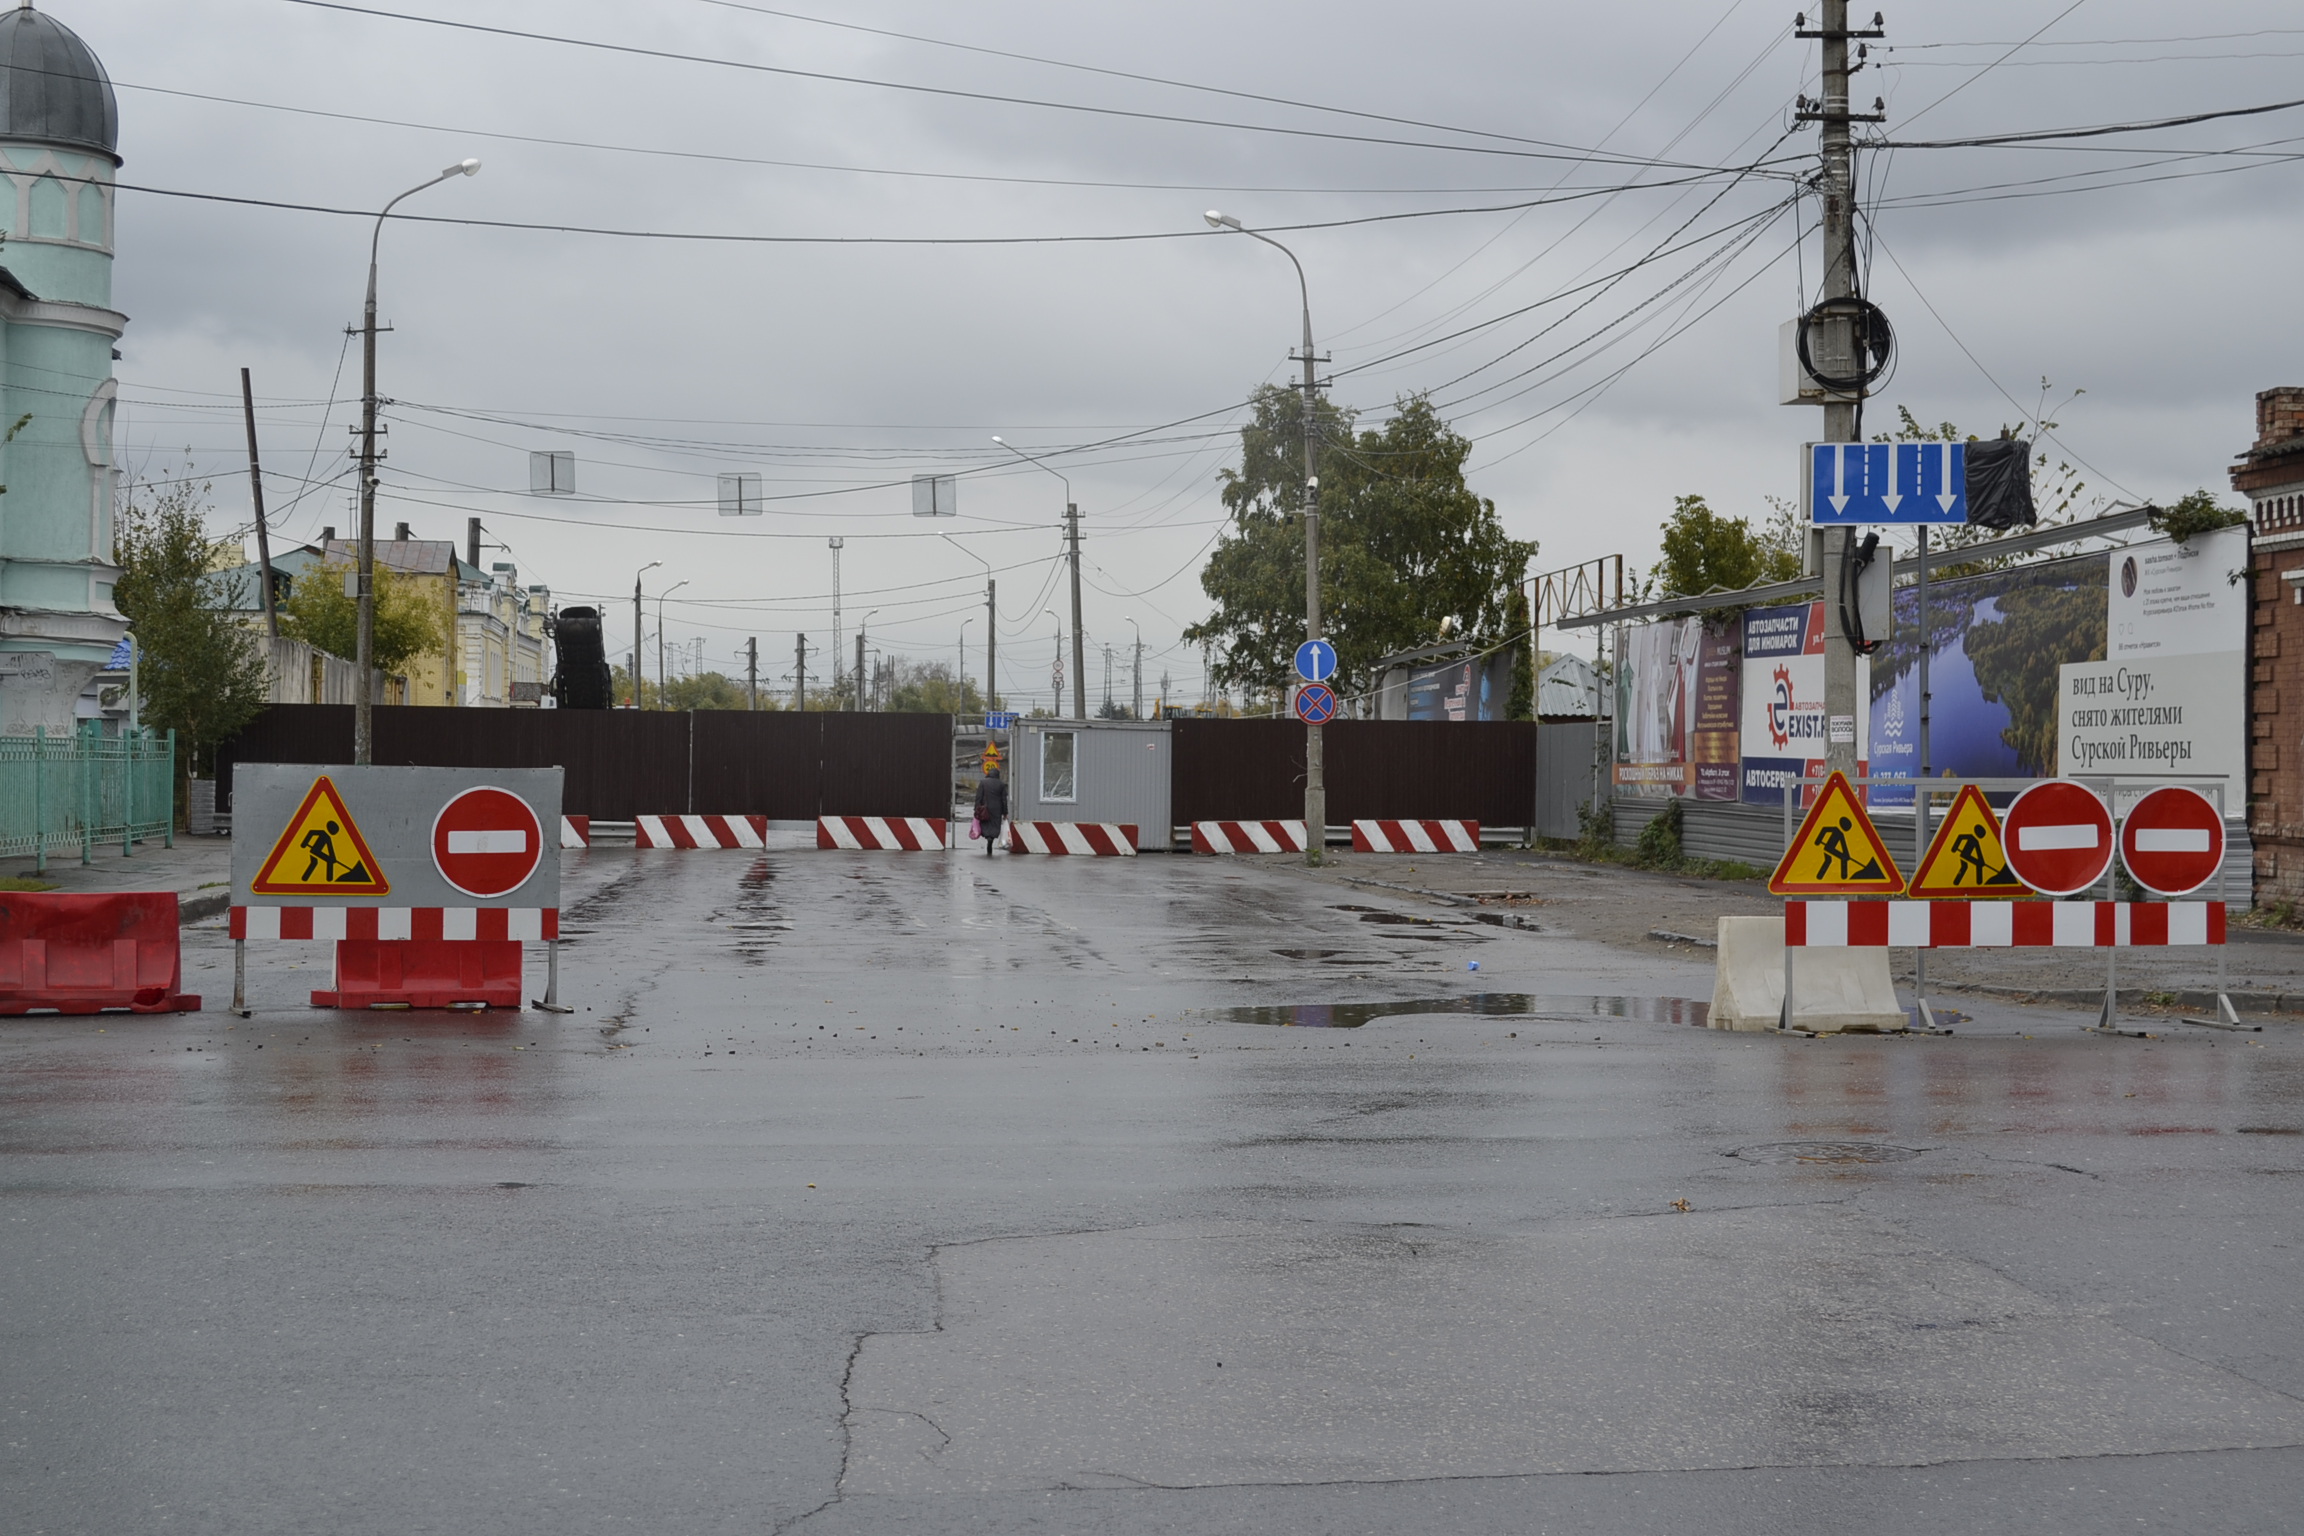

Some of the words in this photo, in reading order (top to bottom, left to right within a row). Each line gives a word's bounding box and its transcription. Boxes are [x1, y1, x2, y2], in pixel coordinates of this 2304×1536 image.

[1747, 616, 1799, 635] АВТОЗАПЧАСТИ
[1747, 636, 1760, 654] ДЛЯ
[1761, 633, 1798, 650] ИНОМАРОК
[2073, 677, 2096, 698] вид
[2098, 675, 2114, 694] на
[2117, 666, 2154, 701] Суру.
[2071, 709, 2107, 728] снято
[2110, 706, 2183, 727] жителями
[1873, 741, 1892, 758] Сурская
[1892, 740, 1913, 757] Ривьера
[2072, 735, 2126, 768] Сурской
[2129, 734, 2192, 768] Ривьеры
